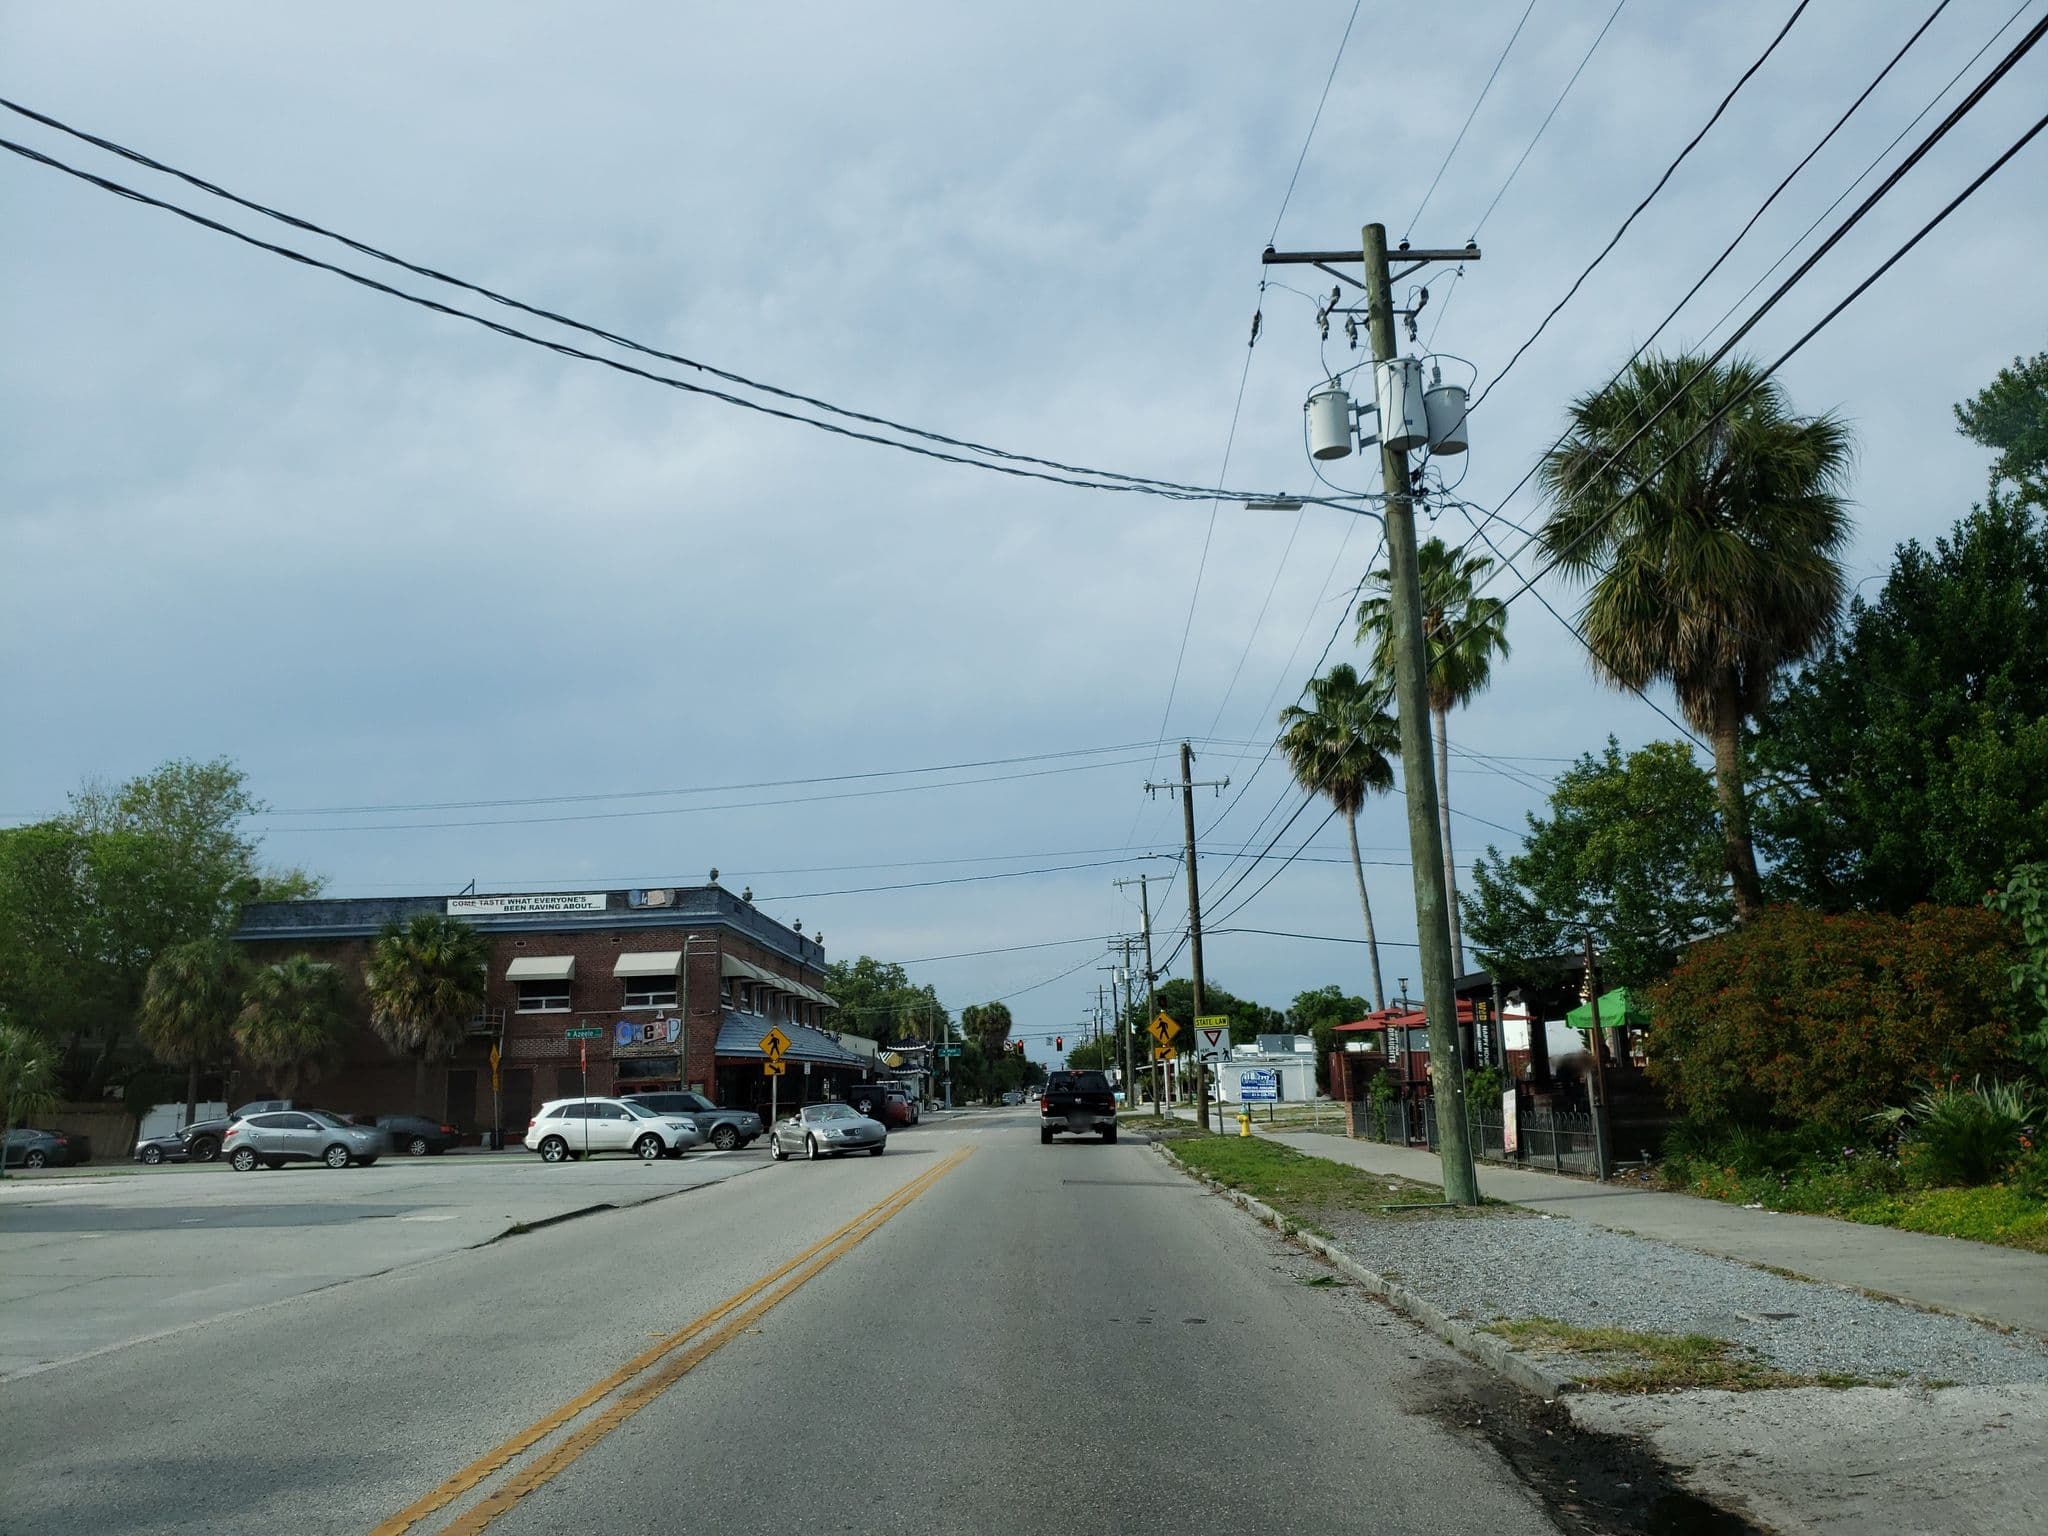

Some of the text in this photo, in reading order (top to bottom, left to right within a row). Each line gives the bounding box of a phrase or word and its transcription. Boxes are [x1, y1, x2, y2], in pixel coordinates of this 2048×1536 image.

[479, 899, 505, 907] TASTE
[534, 896, 586, 904] EVERYONE'S
[1196, 1017, 1227, 1026] STATE LAW
